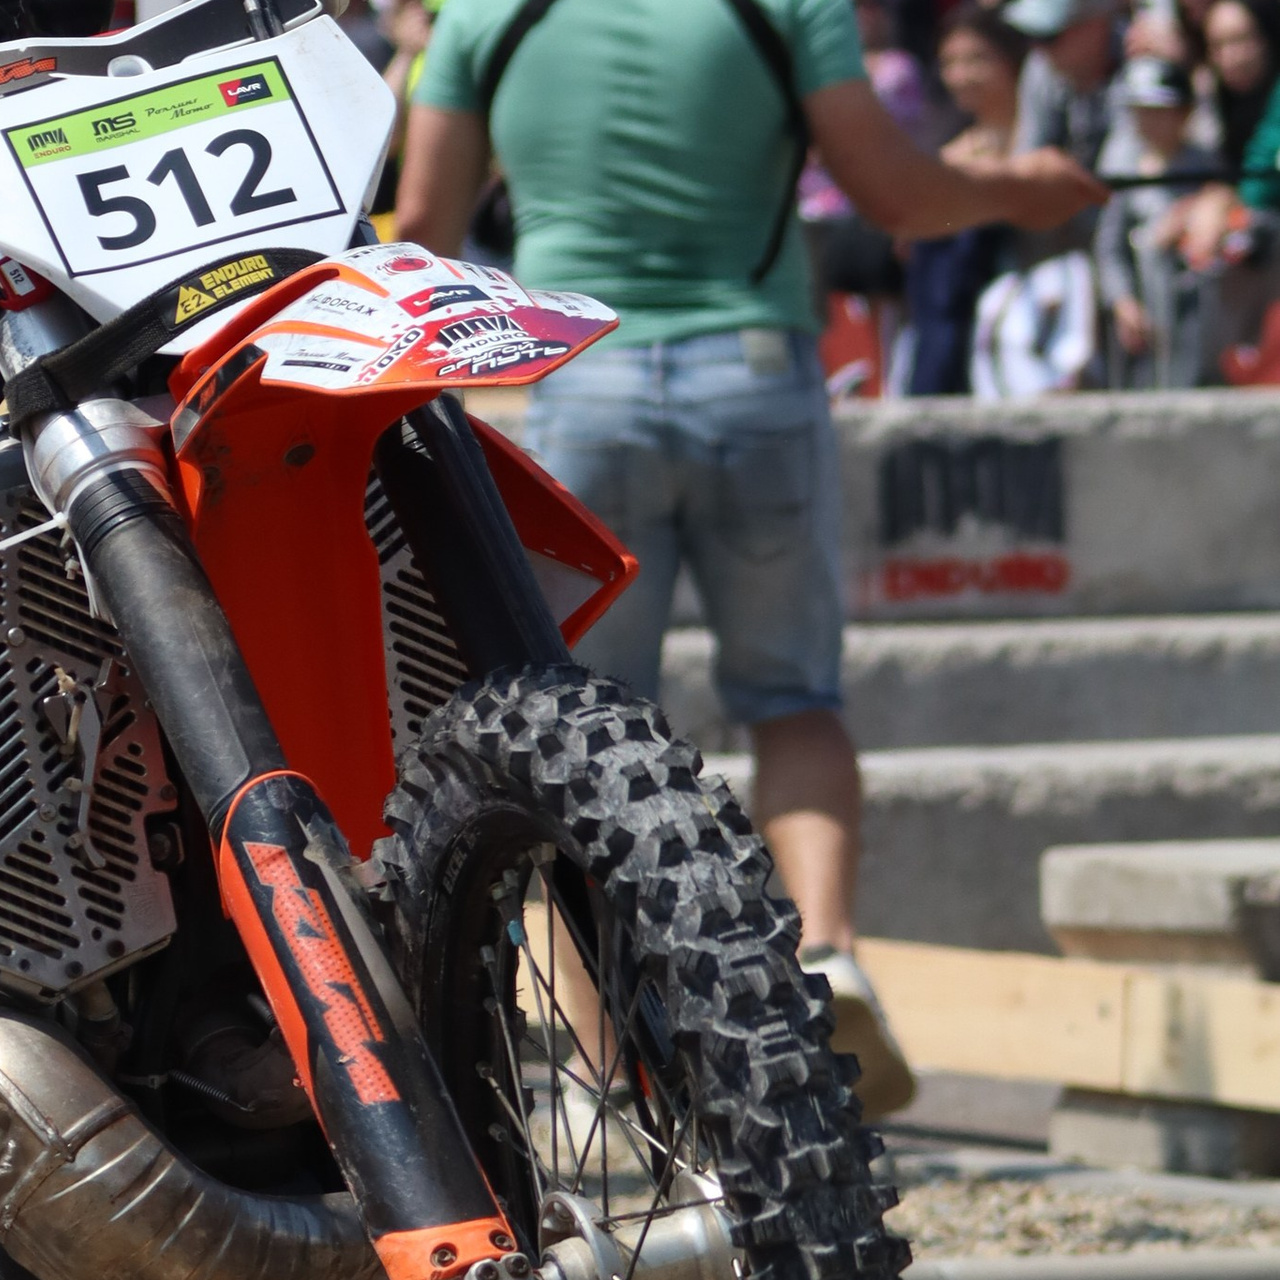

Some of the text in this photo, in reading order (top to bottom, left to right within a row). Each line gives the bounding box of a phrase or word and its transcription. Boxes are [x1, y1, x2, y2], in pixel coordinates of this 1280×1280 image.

[227, 82, 262, 96] LAVR
[96, 128, 140, 143] MARSHAL
[34, 144, 72, 159] ENDURO
[75, 128, 298, 250] 512
[9, 268, 25, 285] 512
[199, 254, 270, 290] ENDURO
[211, 267, 275, 299] ELEMENT
[321, 295, 379, 317] ФОРСАЖ
[413, 289, 472, 306] LAVR
[452, 331, 528, 356] ENDURO
[471, 346, 568, 374] ПУТЬ
[243, 840, 402, 1104] KTM
